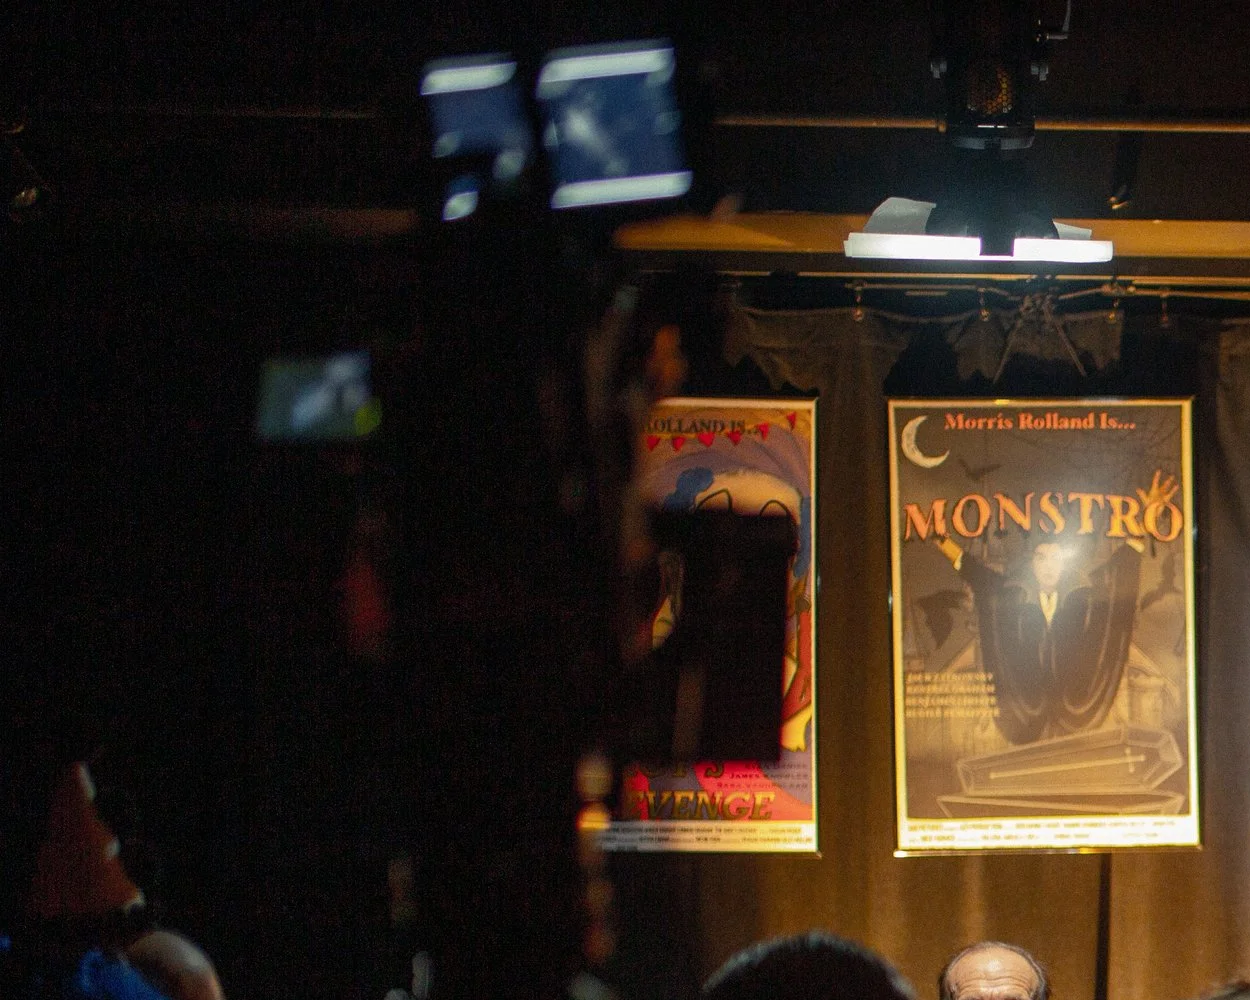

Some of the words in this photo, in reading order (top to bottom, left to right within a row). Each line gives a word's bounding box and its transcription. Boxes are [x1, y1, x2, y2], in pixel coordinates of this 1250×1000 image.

[944, 412, 1013, 430] Morris
[1018, 411, 1095, 430] Rolland
[1099, 412, 1136, 430] Is...
[904, 491, 1183, 542] MONSTRO
[626, 790, 776, 820] EVENGE
